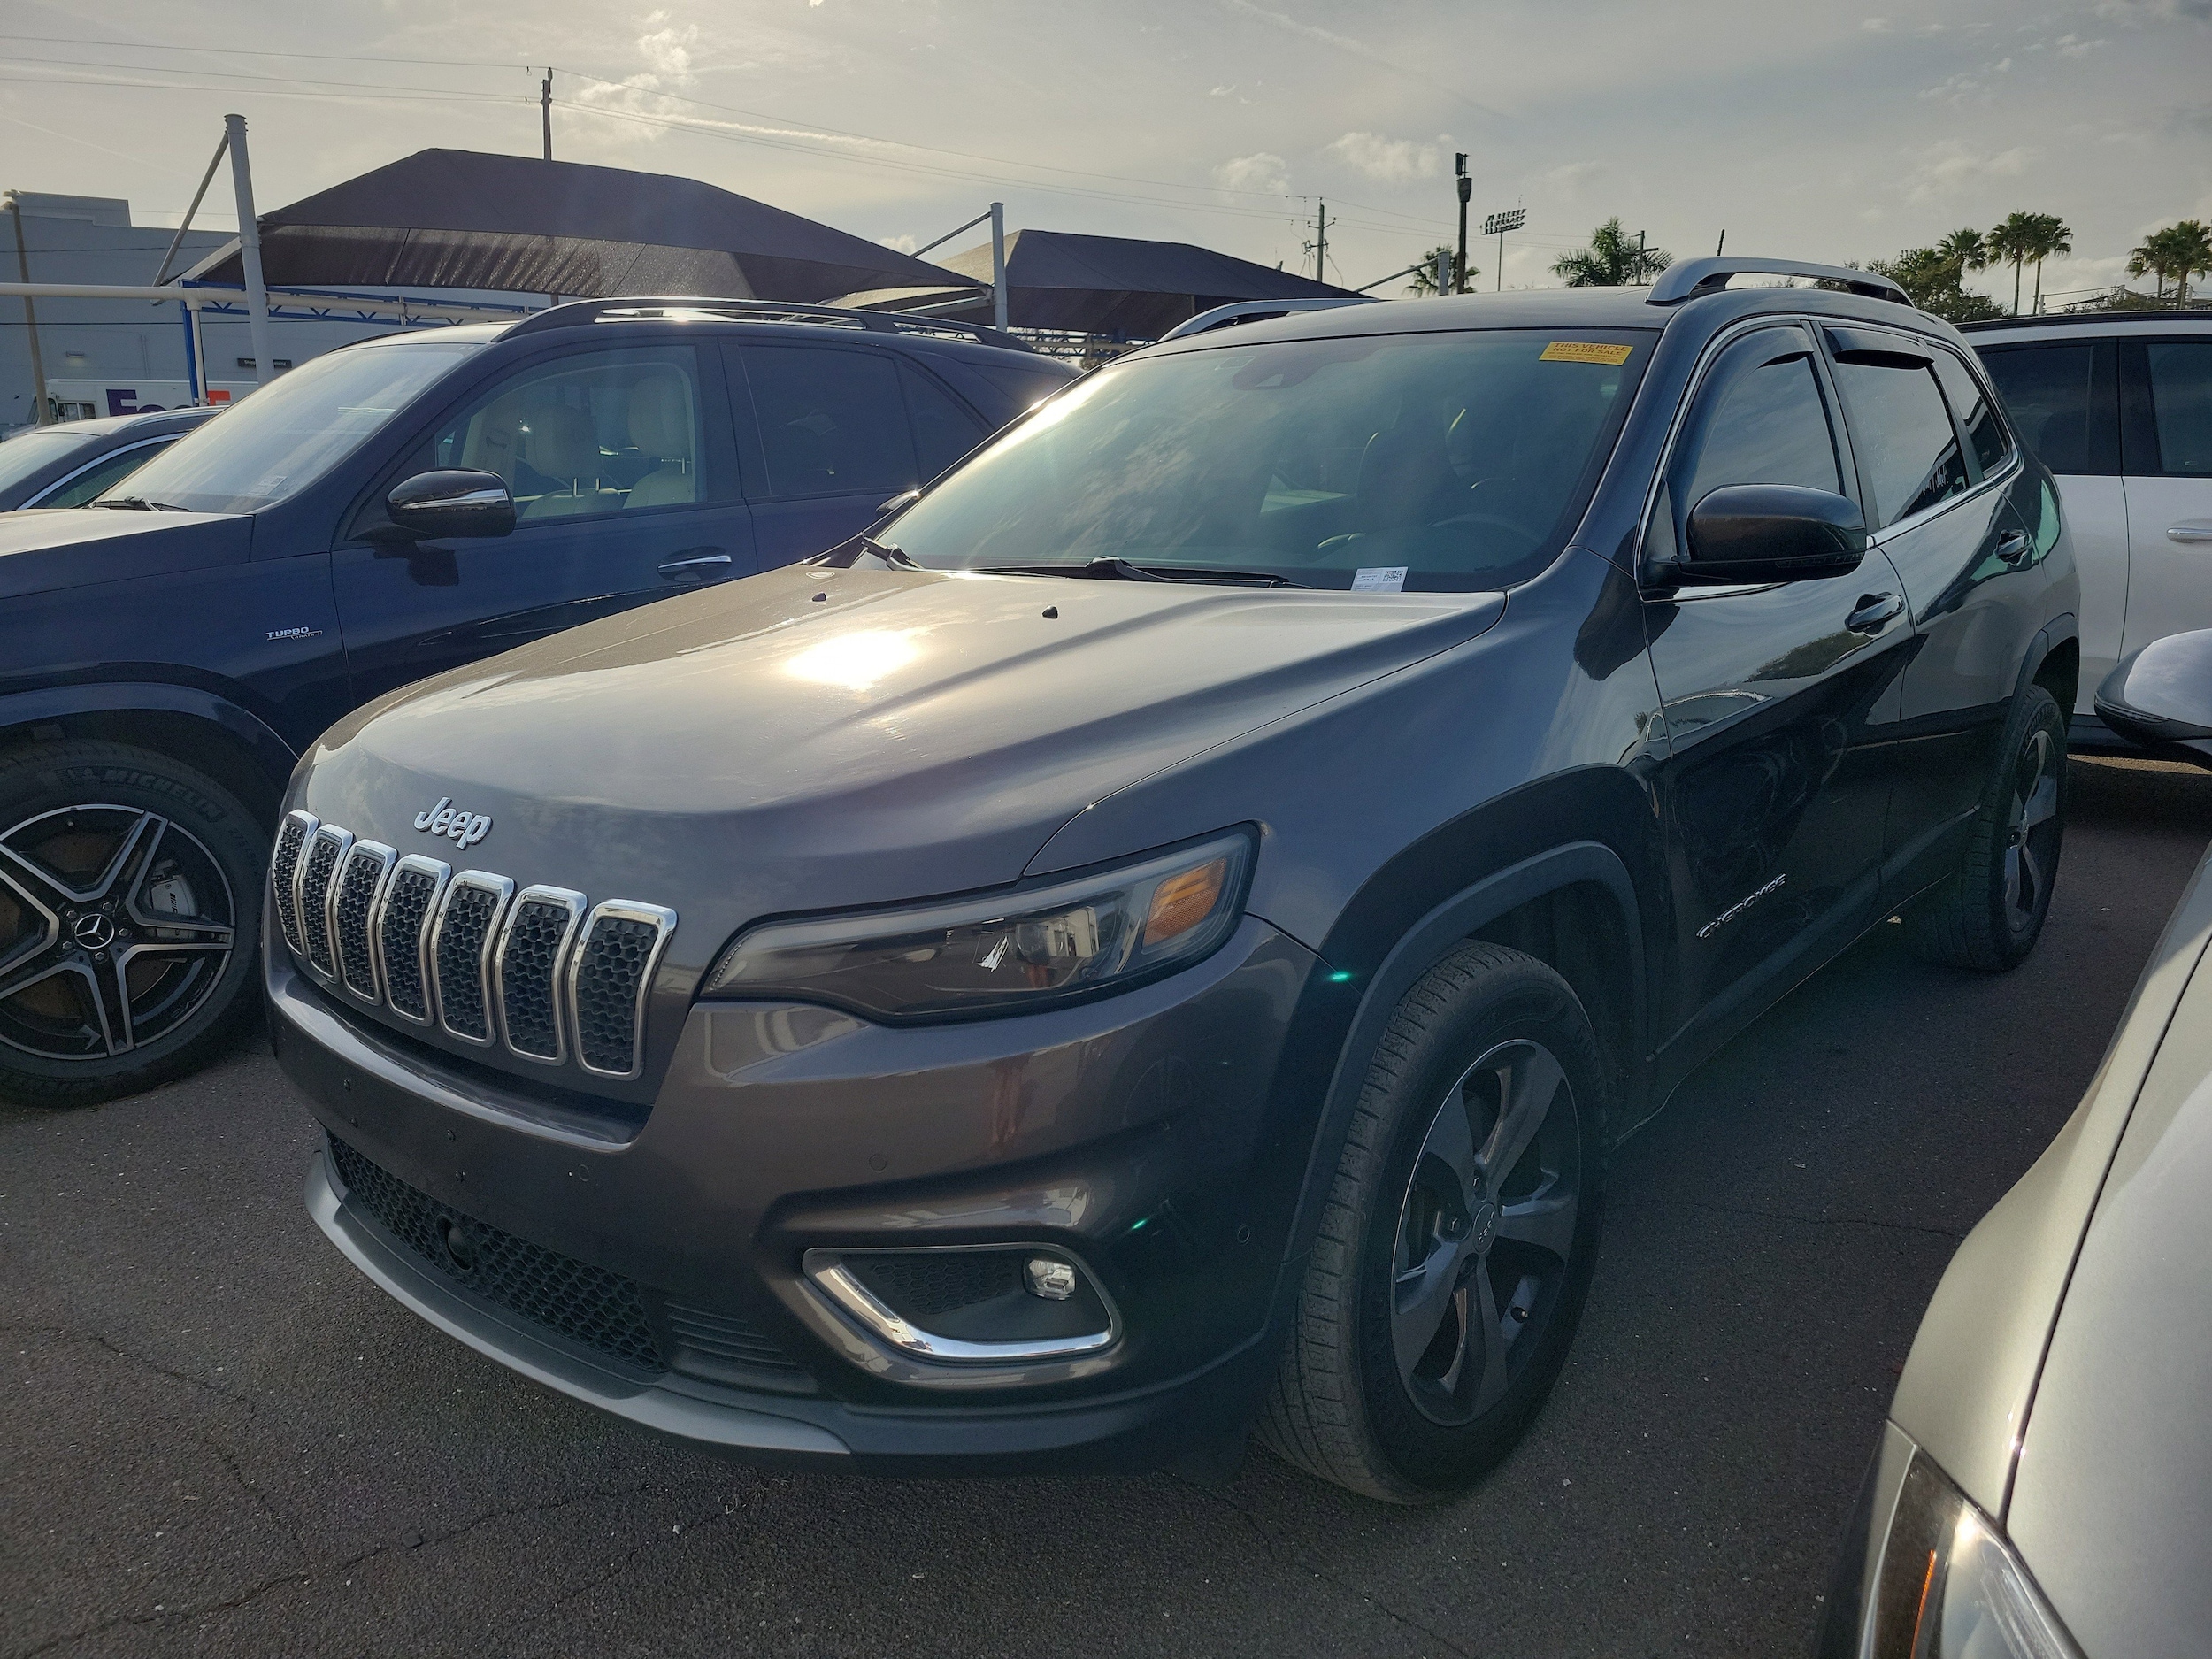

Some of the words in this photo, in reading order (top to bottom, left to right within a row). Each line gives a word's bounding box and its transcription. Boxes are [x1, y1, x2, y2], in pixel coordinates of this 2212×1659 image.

[1582, 343, 1628, 352] VEHICLE
[265, 626, 309, 638] TURBO
[104, 768, 221, 818] MICHELIN
[413, 796, 493, 850] Jeep
[1696, 873, 1786, 938] CHEROKEE
